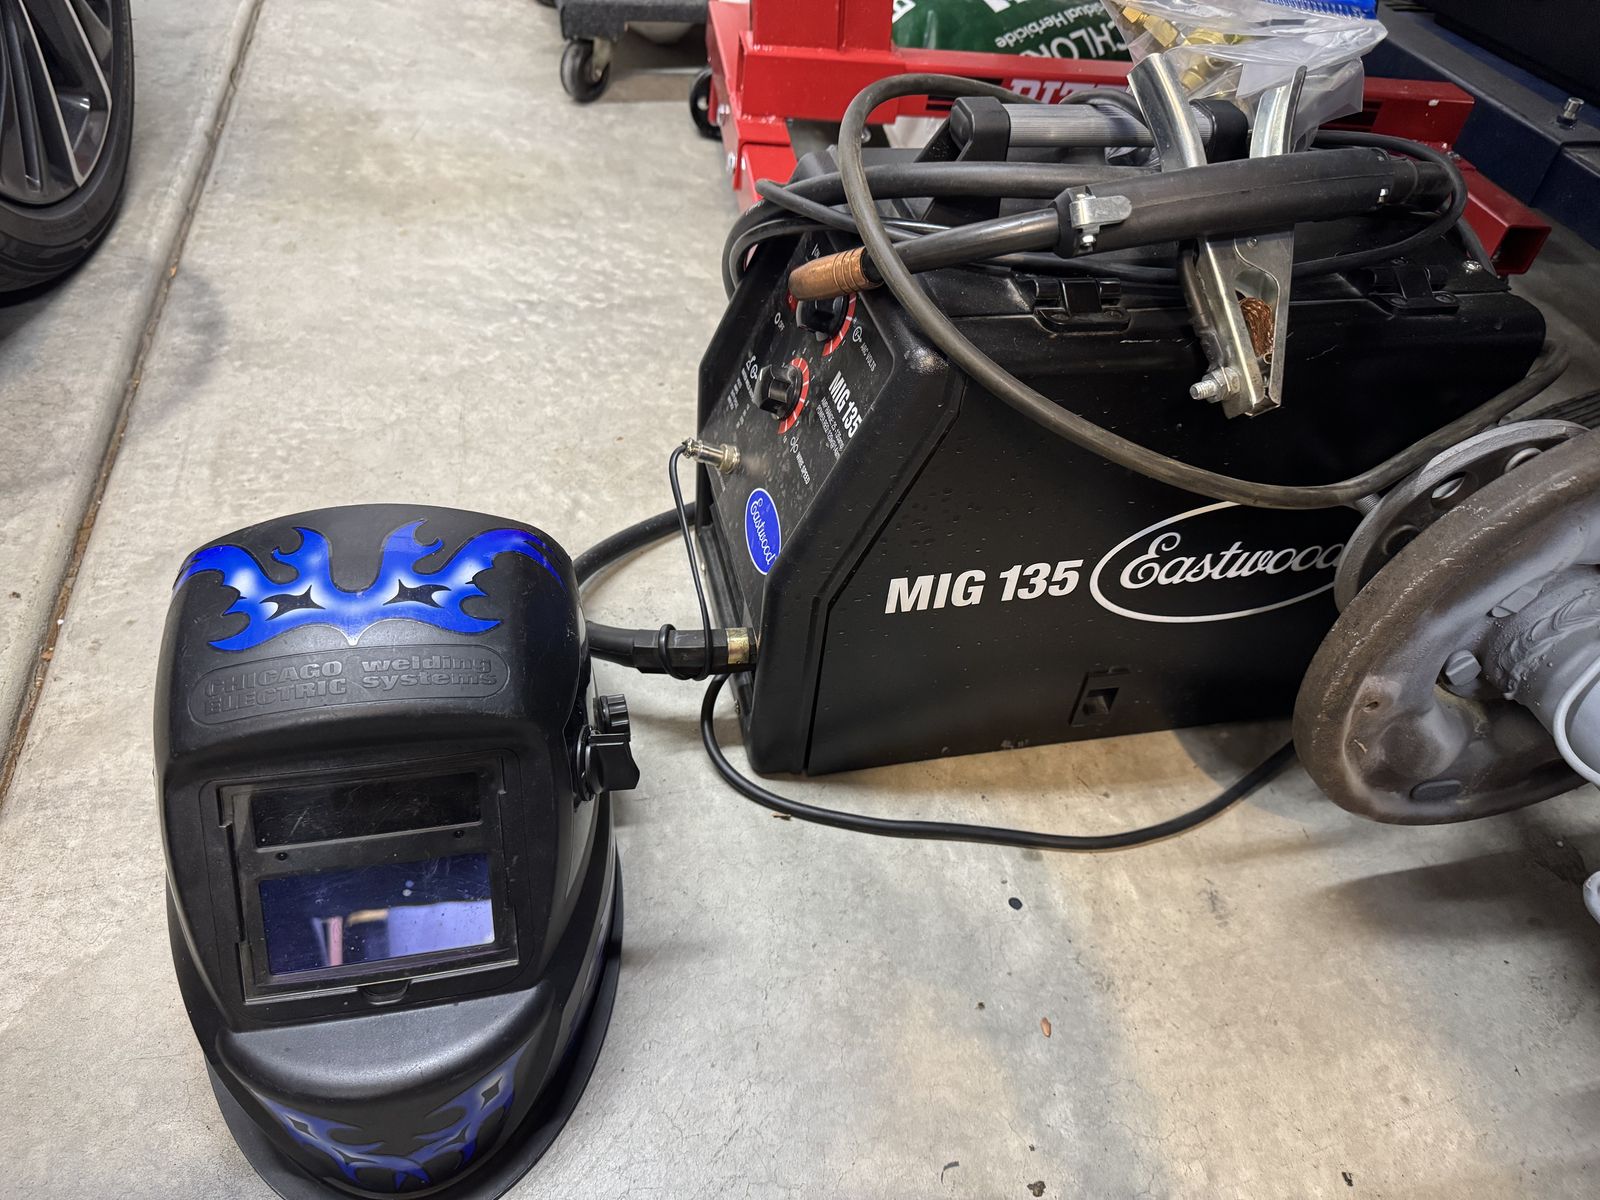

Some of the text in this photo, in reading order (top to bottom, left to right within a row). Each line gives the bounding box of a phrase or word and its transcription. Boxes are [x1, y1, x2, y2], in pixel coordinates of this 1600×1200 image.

[995, 11, 1068, 48] Herbicide
[829, 370, 850, 414] MIG
[842, 401, 863, 439] 135
[750, 497, 776, 566] Eastwood
[884, 558, 1084, 614] MIG 135
[204, 660, 343, 697] CHICAGO
[361, 655, 493, 674] welding
[361, 671, 498, 692] systems
[205, 678, 347, 716] ELECTRIC
